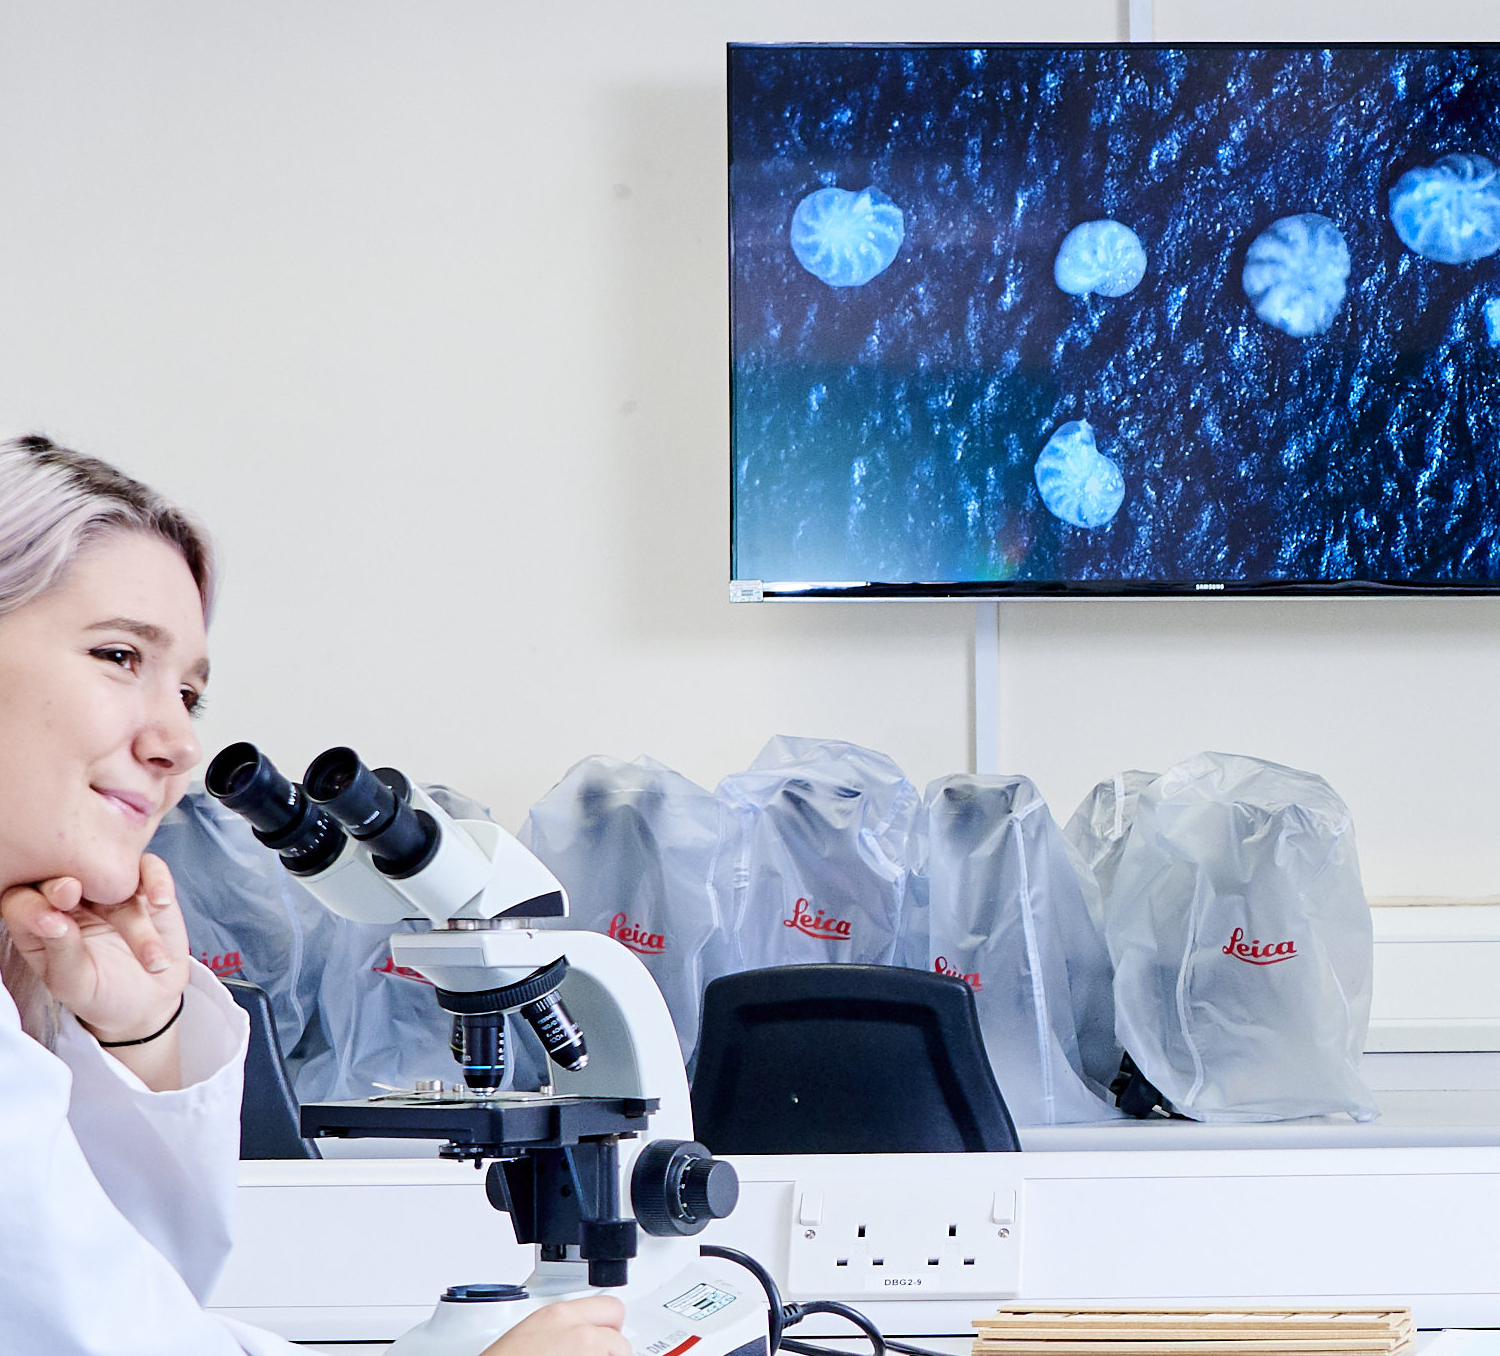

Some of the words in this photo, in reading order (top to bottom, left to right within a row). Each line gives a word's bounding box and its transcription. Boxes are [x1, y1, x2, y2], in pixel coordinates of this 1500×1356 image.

[783, 897, 851, 941] Leica
[1222, 927, 1299, 965] Leica
[884, 1277, 923, 1287] DBG2-9
[647, 1340, 670, 1355] DM
